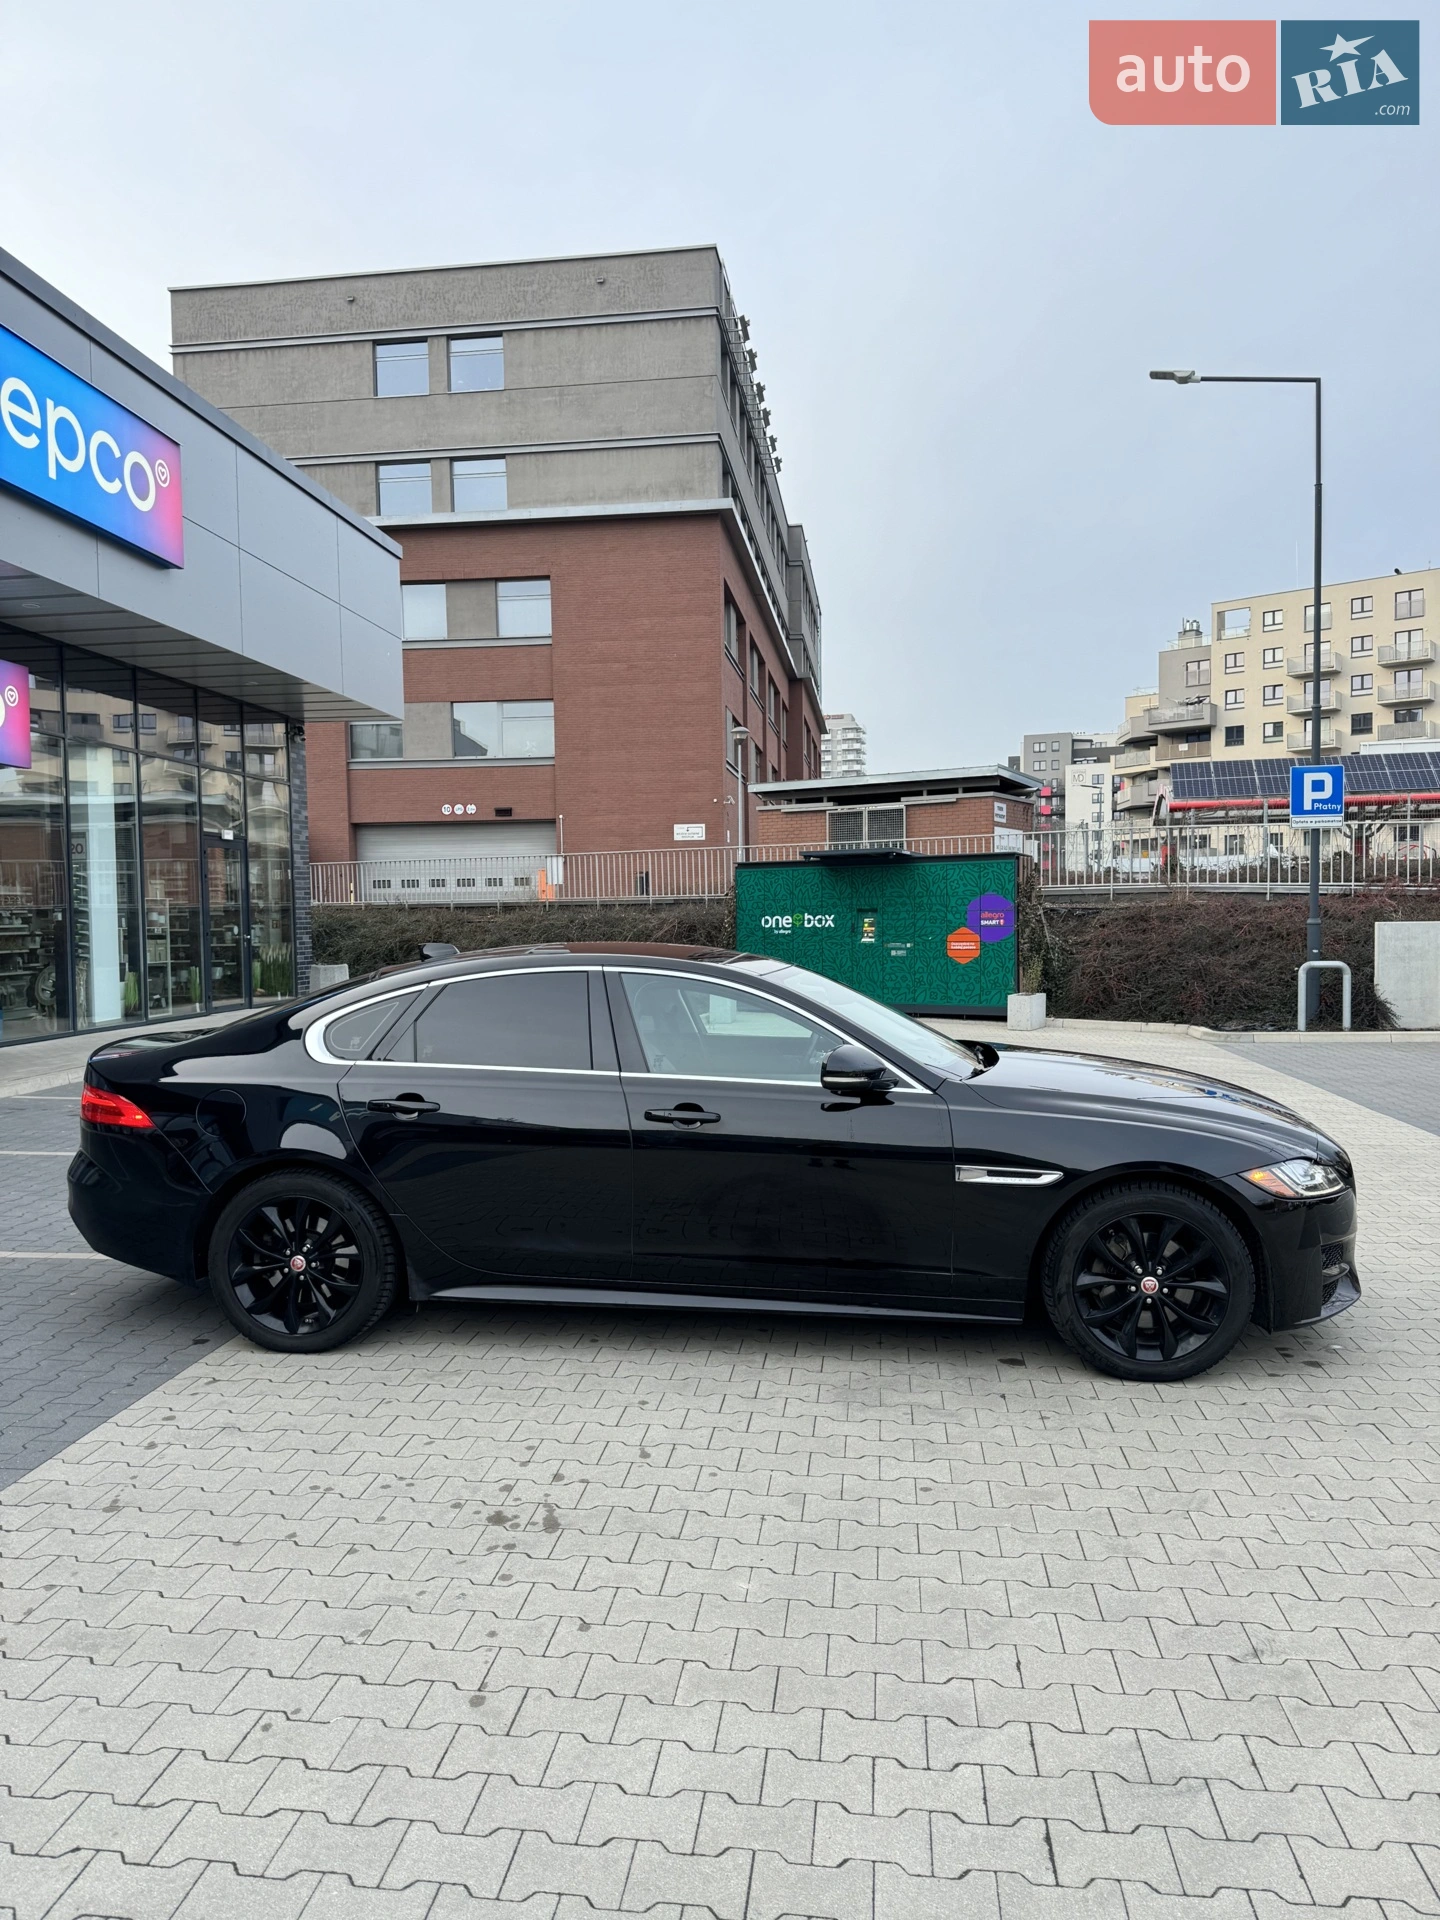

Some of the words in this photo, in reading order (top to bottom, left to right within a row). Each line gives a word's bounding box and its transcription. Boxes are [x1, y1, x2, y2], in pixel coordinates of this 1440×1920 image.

[0, 376, 156, 512] epco
[1304, 772, 1332, 810] P
[1314, 803, 1341, 811] Płatny
[761, 915, 792, 928] one
[803, 912, 835, 928] box
[980, 911, 1004, 919] allegro
